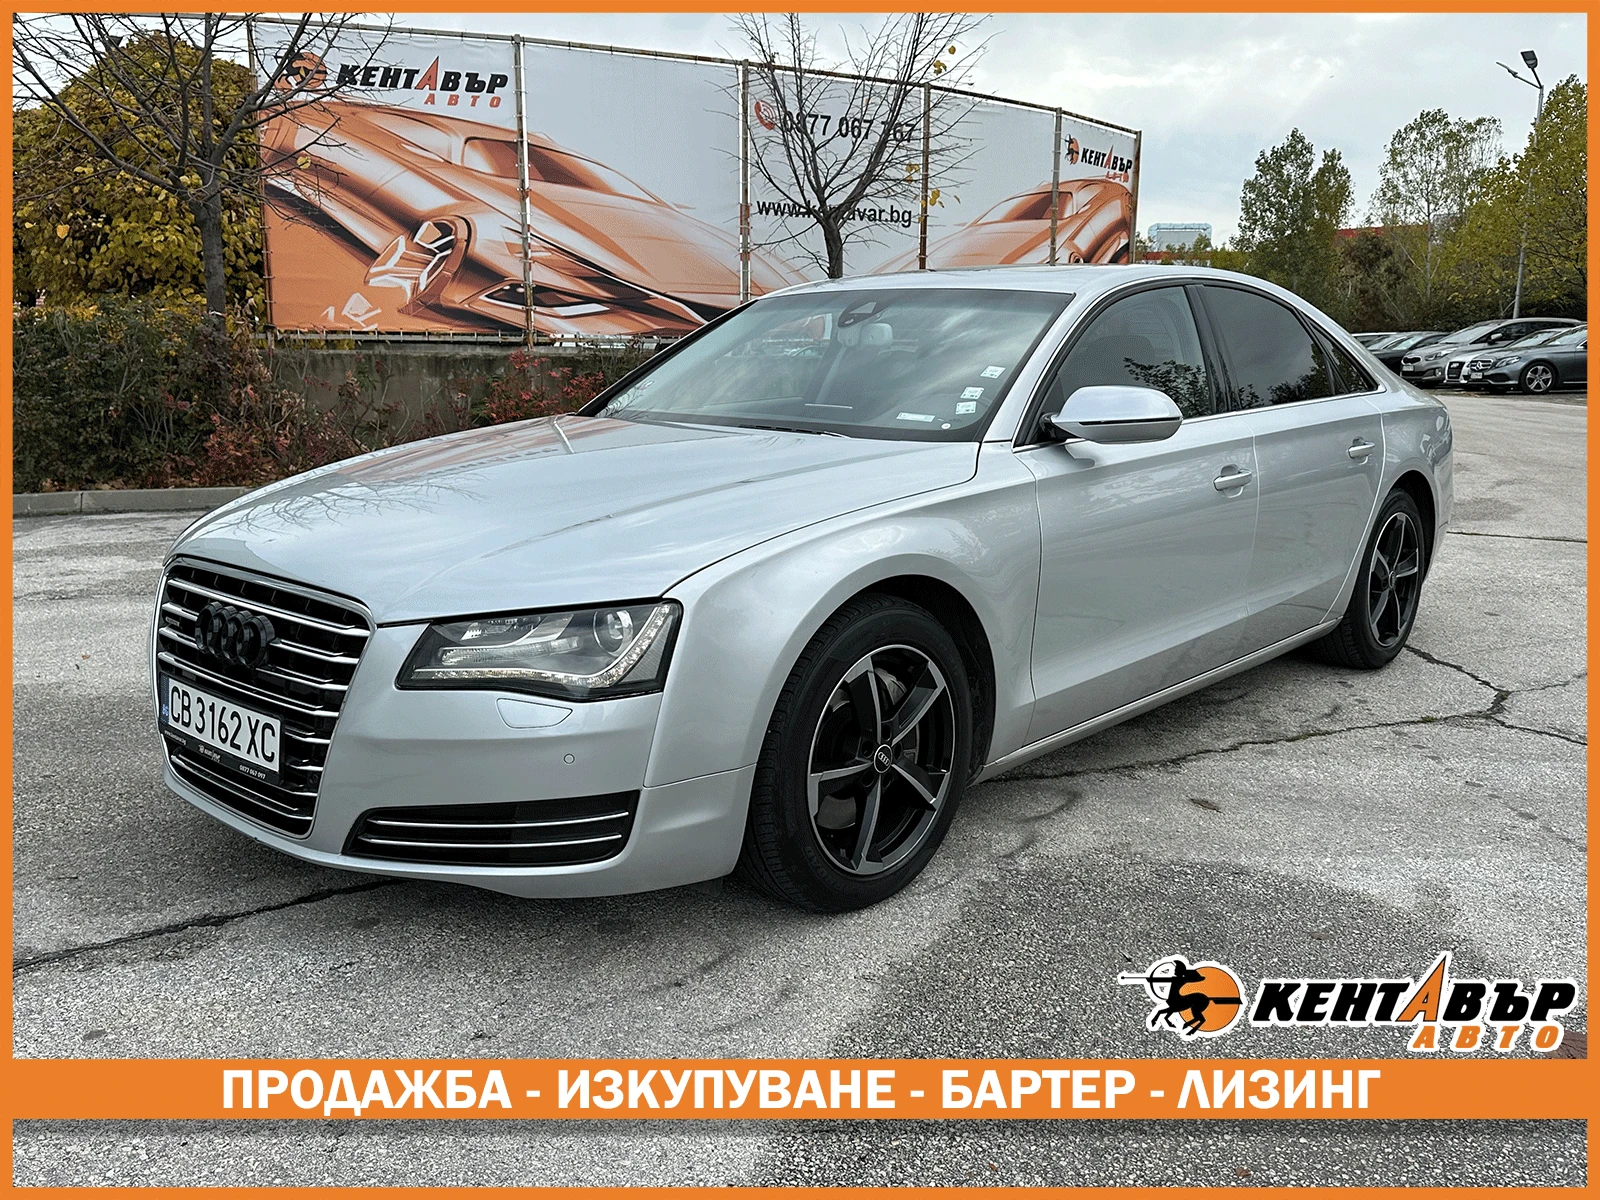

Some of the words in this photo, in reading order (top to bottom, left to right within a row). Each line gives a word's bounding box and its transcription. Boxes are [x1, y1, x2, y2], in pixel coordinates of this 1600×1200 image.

[336, 56, 508, 94] КЕНТАВЪР
[424, 93, 502, 108] АВТО
[839, 116, 873, 140] 067
[1081, 145, 1133, 173] КЕНТАВЪР
[195, 696, 242, 752] 3162
